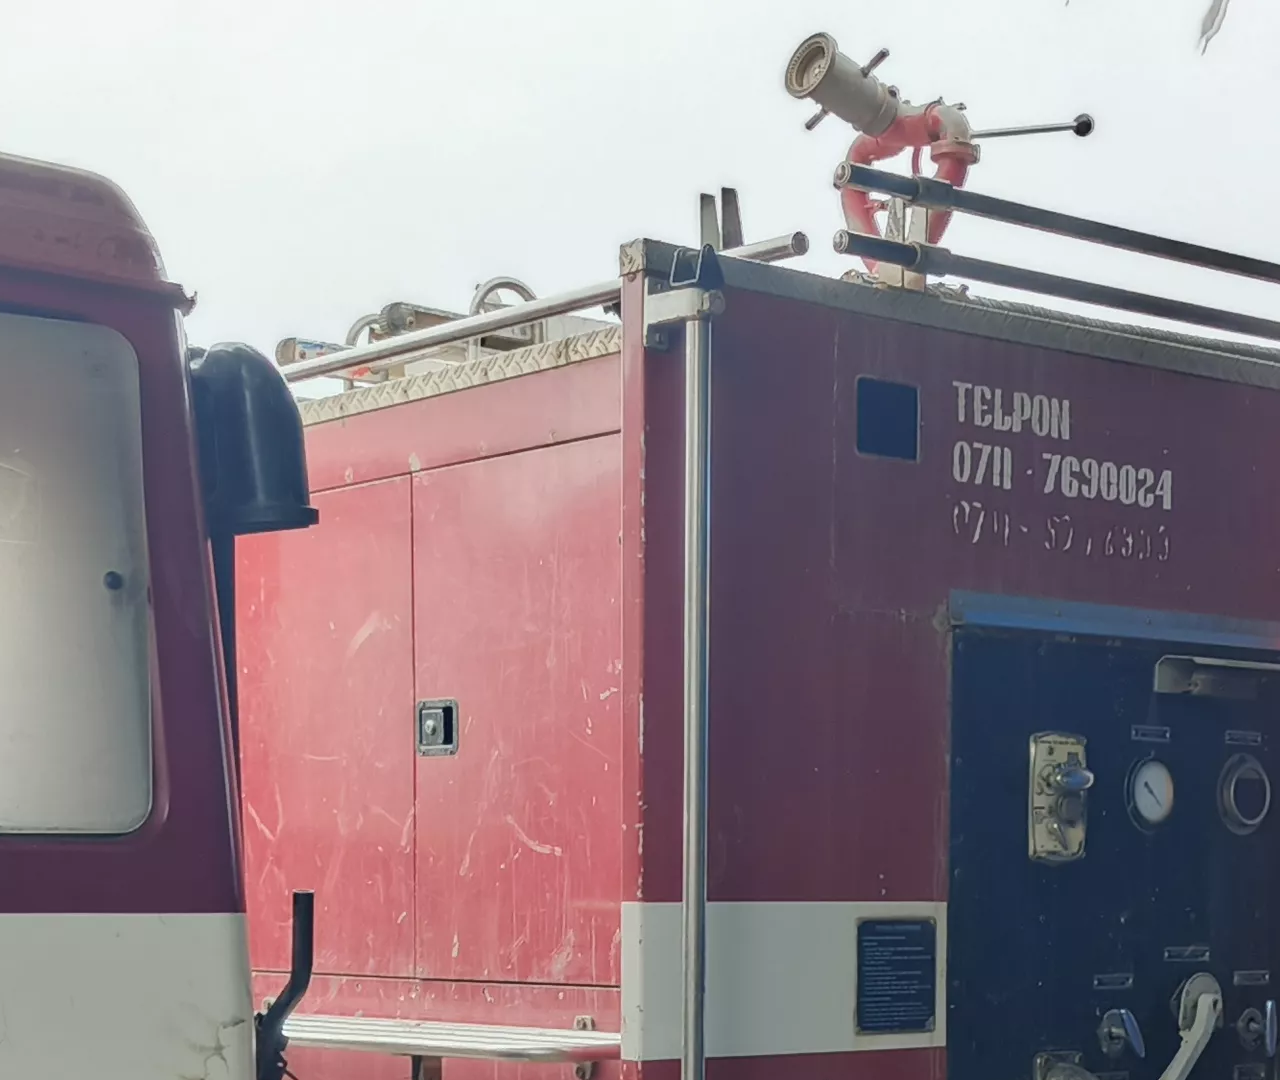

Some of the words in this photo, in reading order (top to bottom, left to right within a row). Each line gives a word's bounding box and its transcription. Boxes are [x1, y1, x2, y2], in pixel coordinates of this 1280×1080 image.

[952, 380, 1070, 440] TELPON
[952, 440, 1012, 490] 0711
[1042, 452, 1173, 510] 7690024
